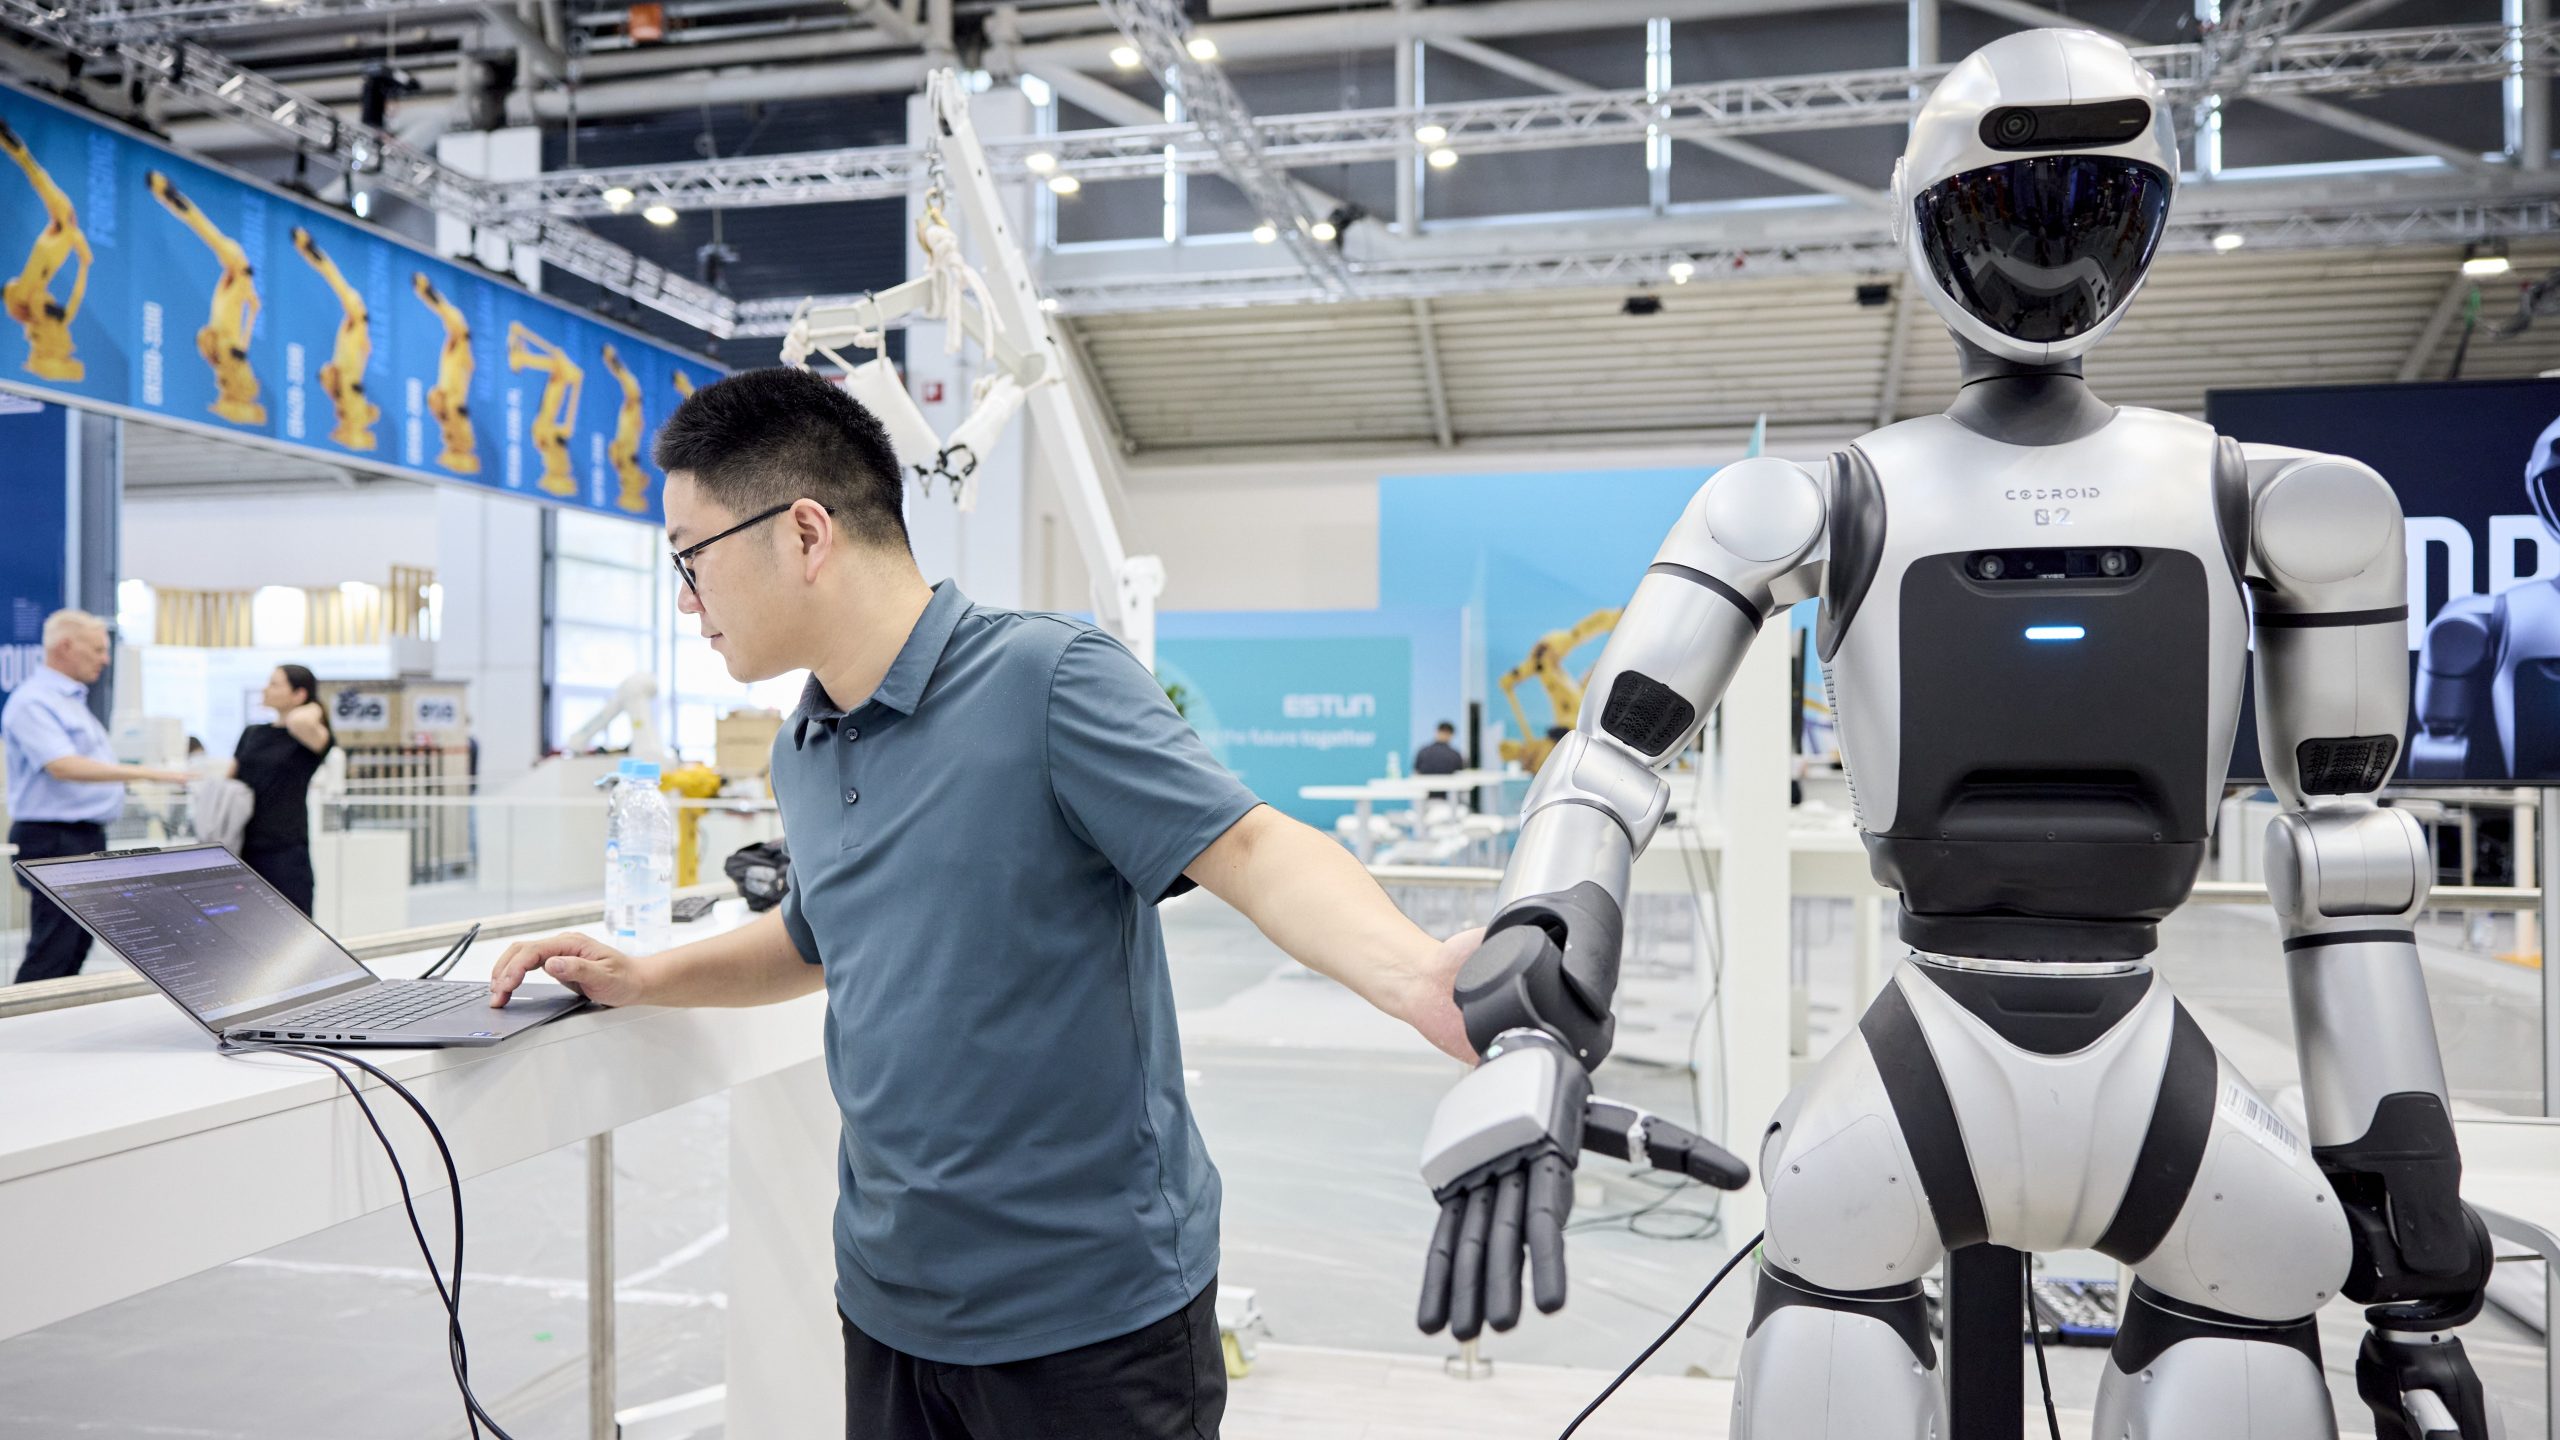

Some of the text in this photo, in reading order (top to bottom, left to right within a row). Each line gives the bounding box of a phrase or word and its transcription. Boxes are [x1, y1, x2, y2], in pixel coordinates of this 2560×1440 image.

[2005, 487, 2101, 501] CODROID
[1282, 693, 1376, 719] ESTUN
[1301, 727, 1377, 751] together
